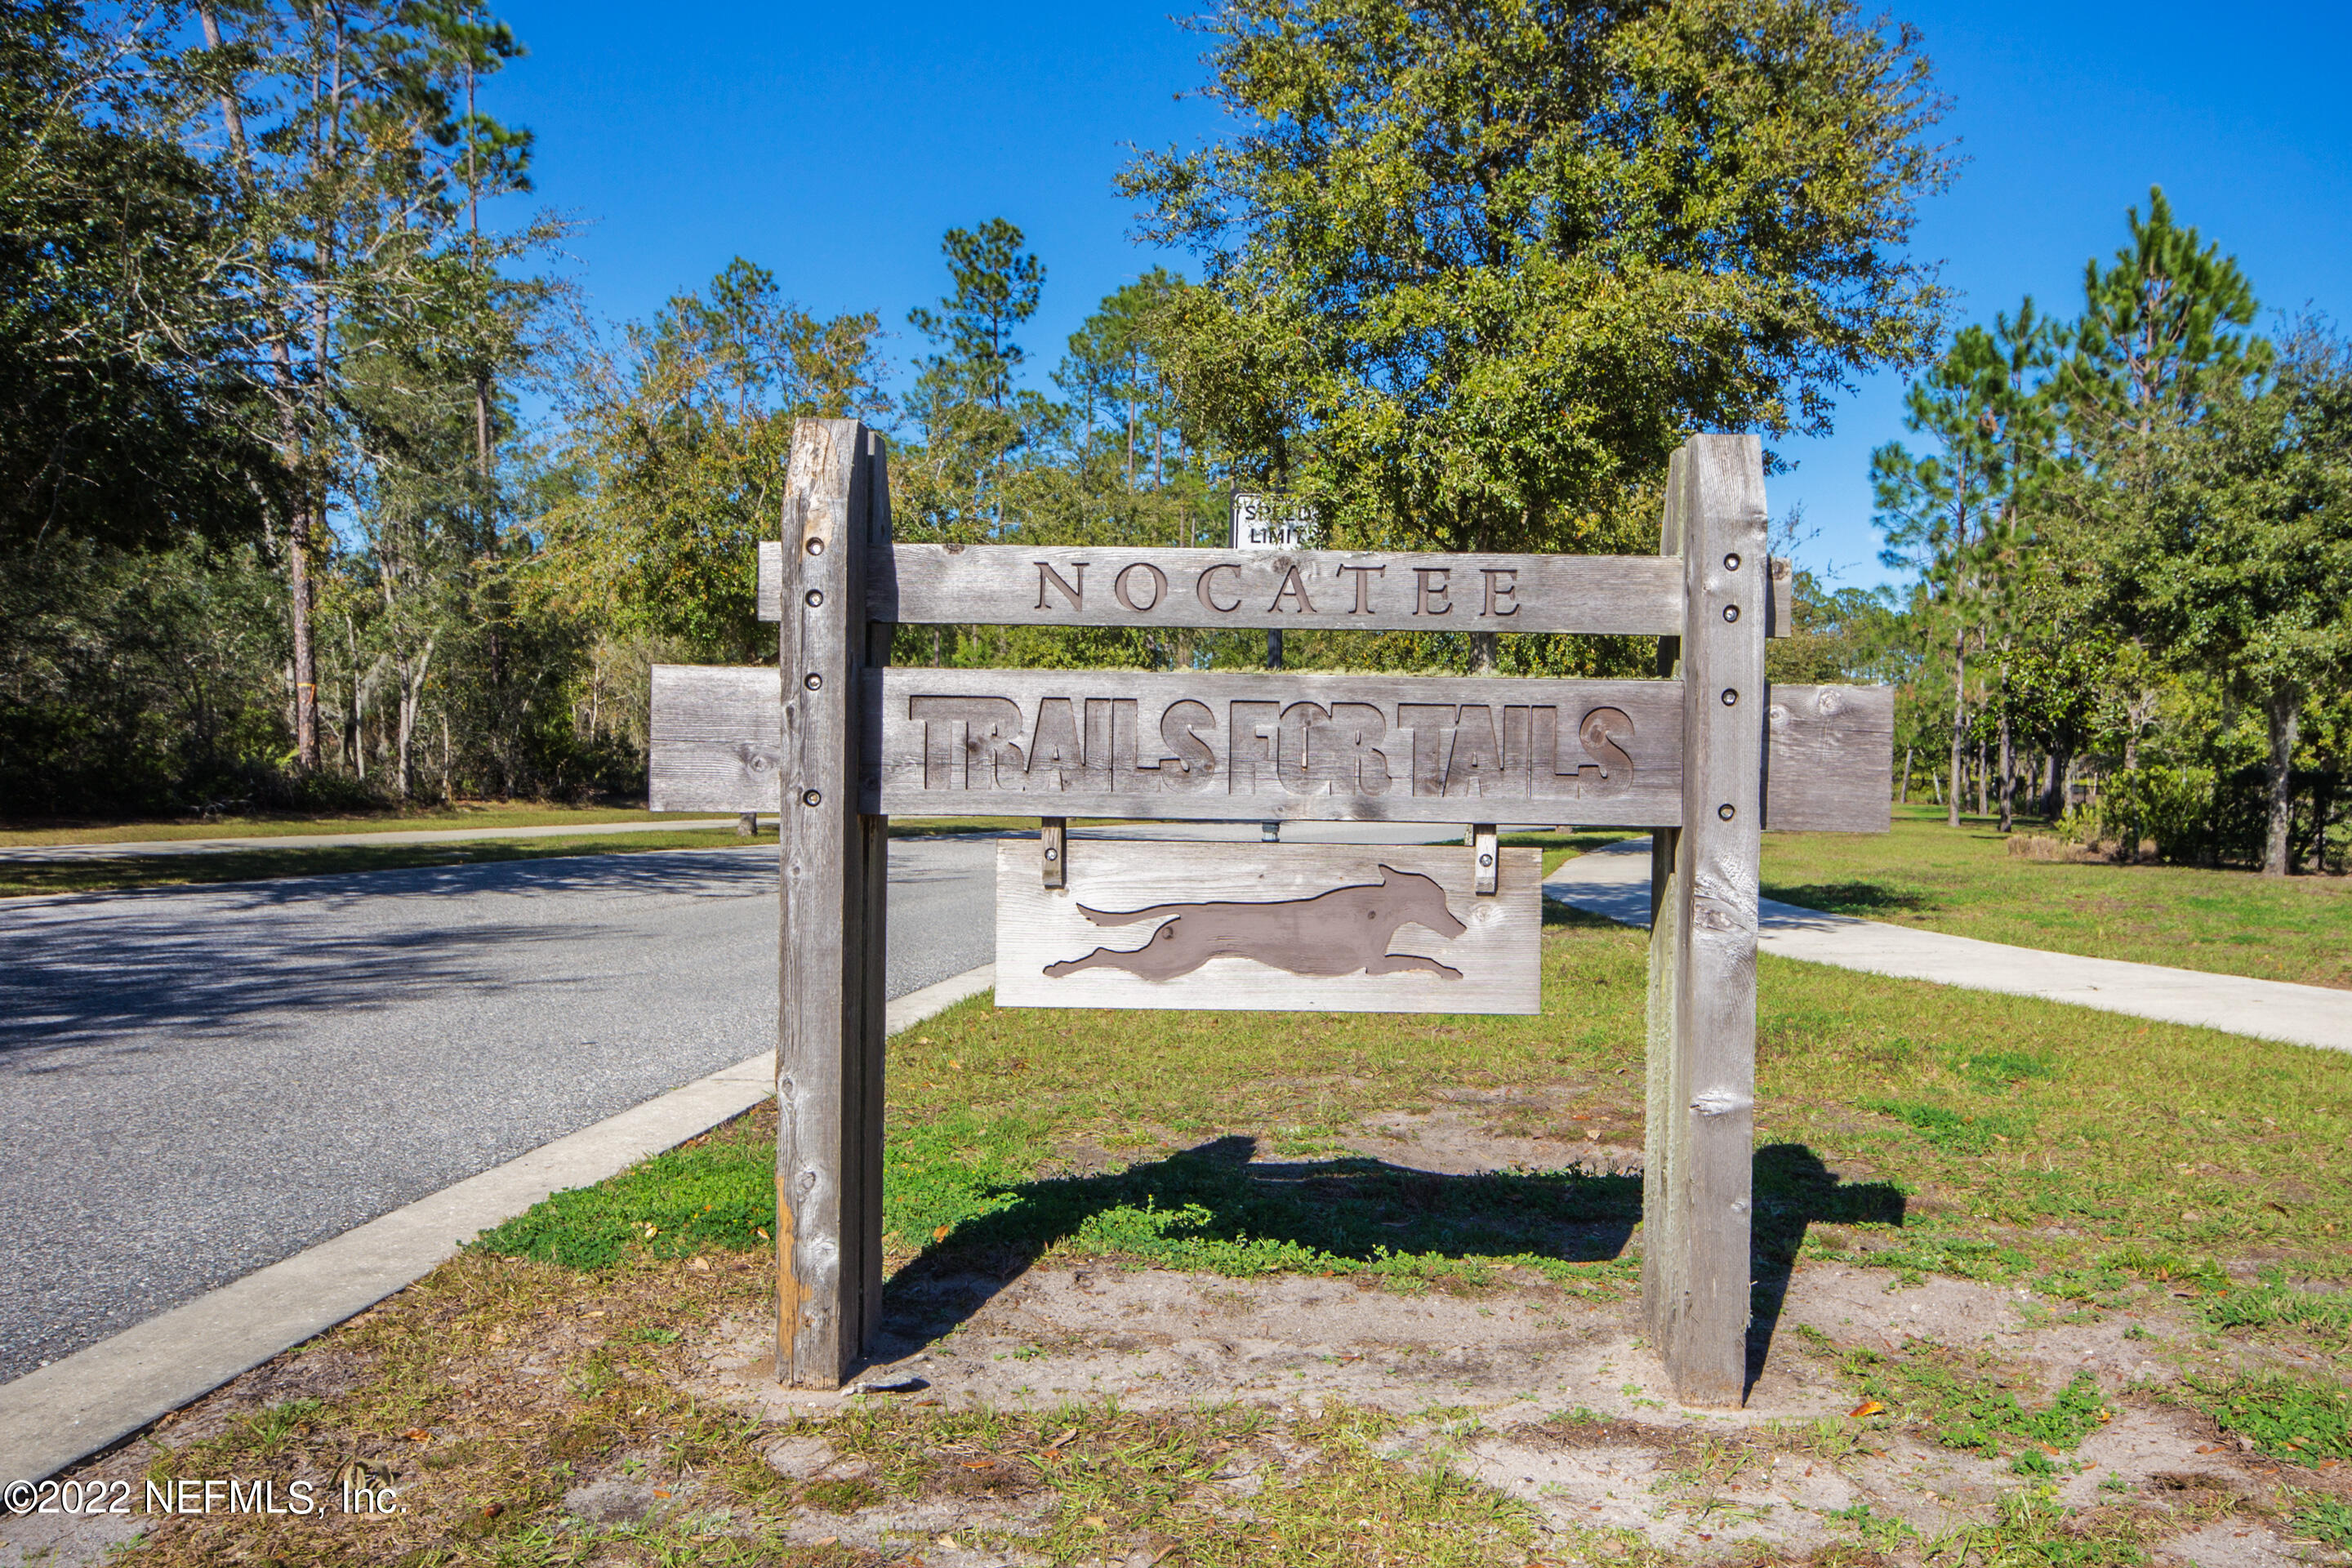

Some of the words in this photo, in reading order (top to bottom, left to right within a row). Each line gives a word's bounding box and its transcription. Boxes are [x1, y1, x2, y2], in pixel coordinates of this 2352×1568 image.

[1250, 528, 1305, 544] LIMIT
[1033, 562, 1521, 617] NOCATEE
[909, 694, 1217, 793] TRAILS
[1228, 699, 1393, 798] FOR
[1397, 703, 1635, 801] TAILS
